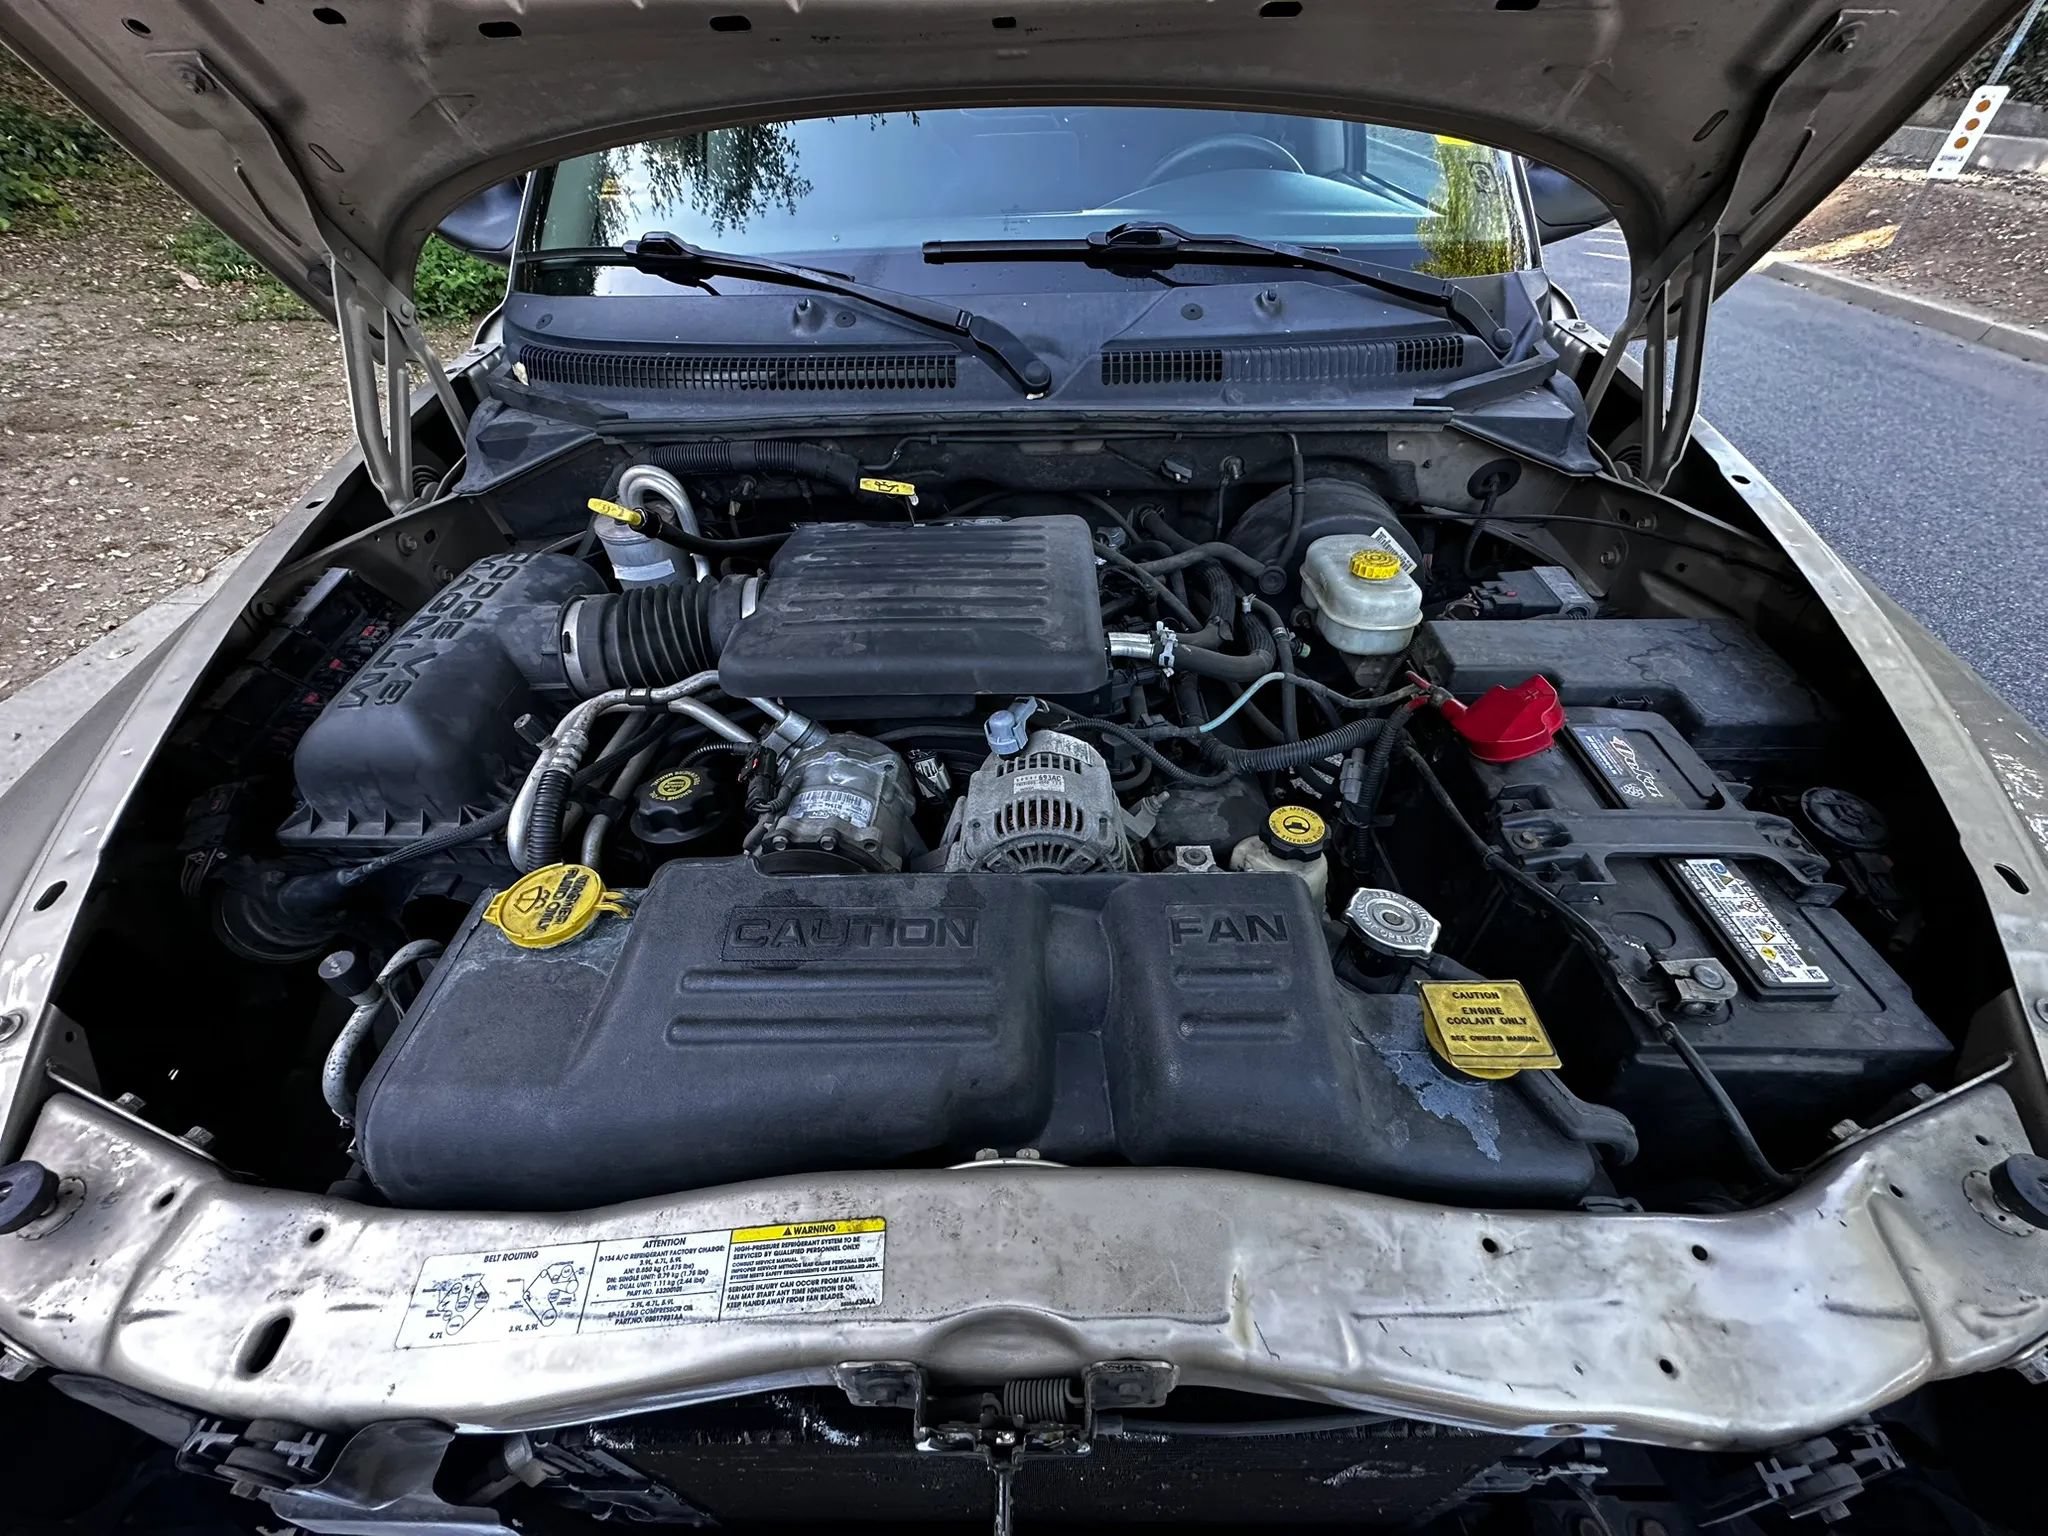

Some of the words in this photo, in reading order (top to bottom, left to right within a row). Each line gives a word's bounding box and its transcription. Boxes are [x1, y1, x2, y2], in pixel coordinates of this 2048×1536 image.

[430, 552, 532, 640] DODGE
[338, 554, 505, 709] MAGNUM
[374, 652, 438, 705] V8
[553, 868, 580, 900] FLUID
[536, 901, 561, 931] ONLY
[732, 917, 977, 949] CAUTION
[1170, 914, 1287, 945] FAN
[1462, 1007, 1504, 1015] ENGINE
[1446, 1017, 1495, 1025] COOLANT
[1500, 1017, 1527, 1025] ONLY
[794, 1224, 835, 1234] WARNING
[643, 1237, 686, 1248] ATTENTION
[734, 1243, 780, 1252] HIGH-PRESSURE
[781, 1240, 820, 1248] REFRIGERANT
[484, 1254, 501, 1262] BELT
[502, 1251, 538, 1261] ROUTING
[630, 1250, 668, 1259] REFRIGERANT
[733, 1252, 762, 1260] SERVICED
[774, 1248, 804, 1256] QUALIFIED
[728, 1285, 754, 1293] SERIOUS
[807, 1285, 836, 1293] IGNITION
[640, 1306, 682, 1315] COMPRESSOR
